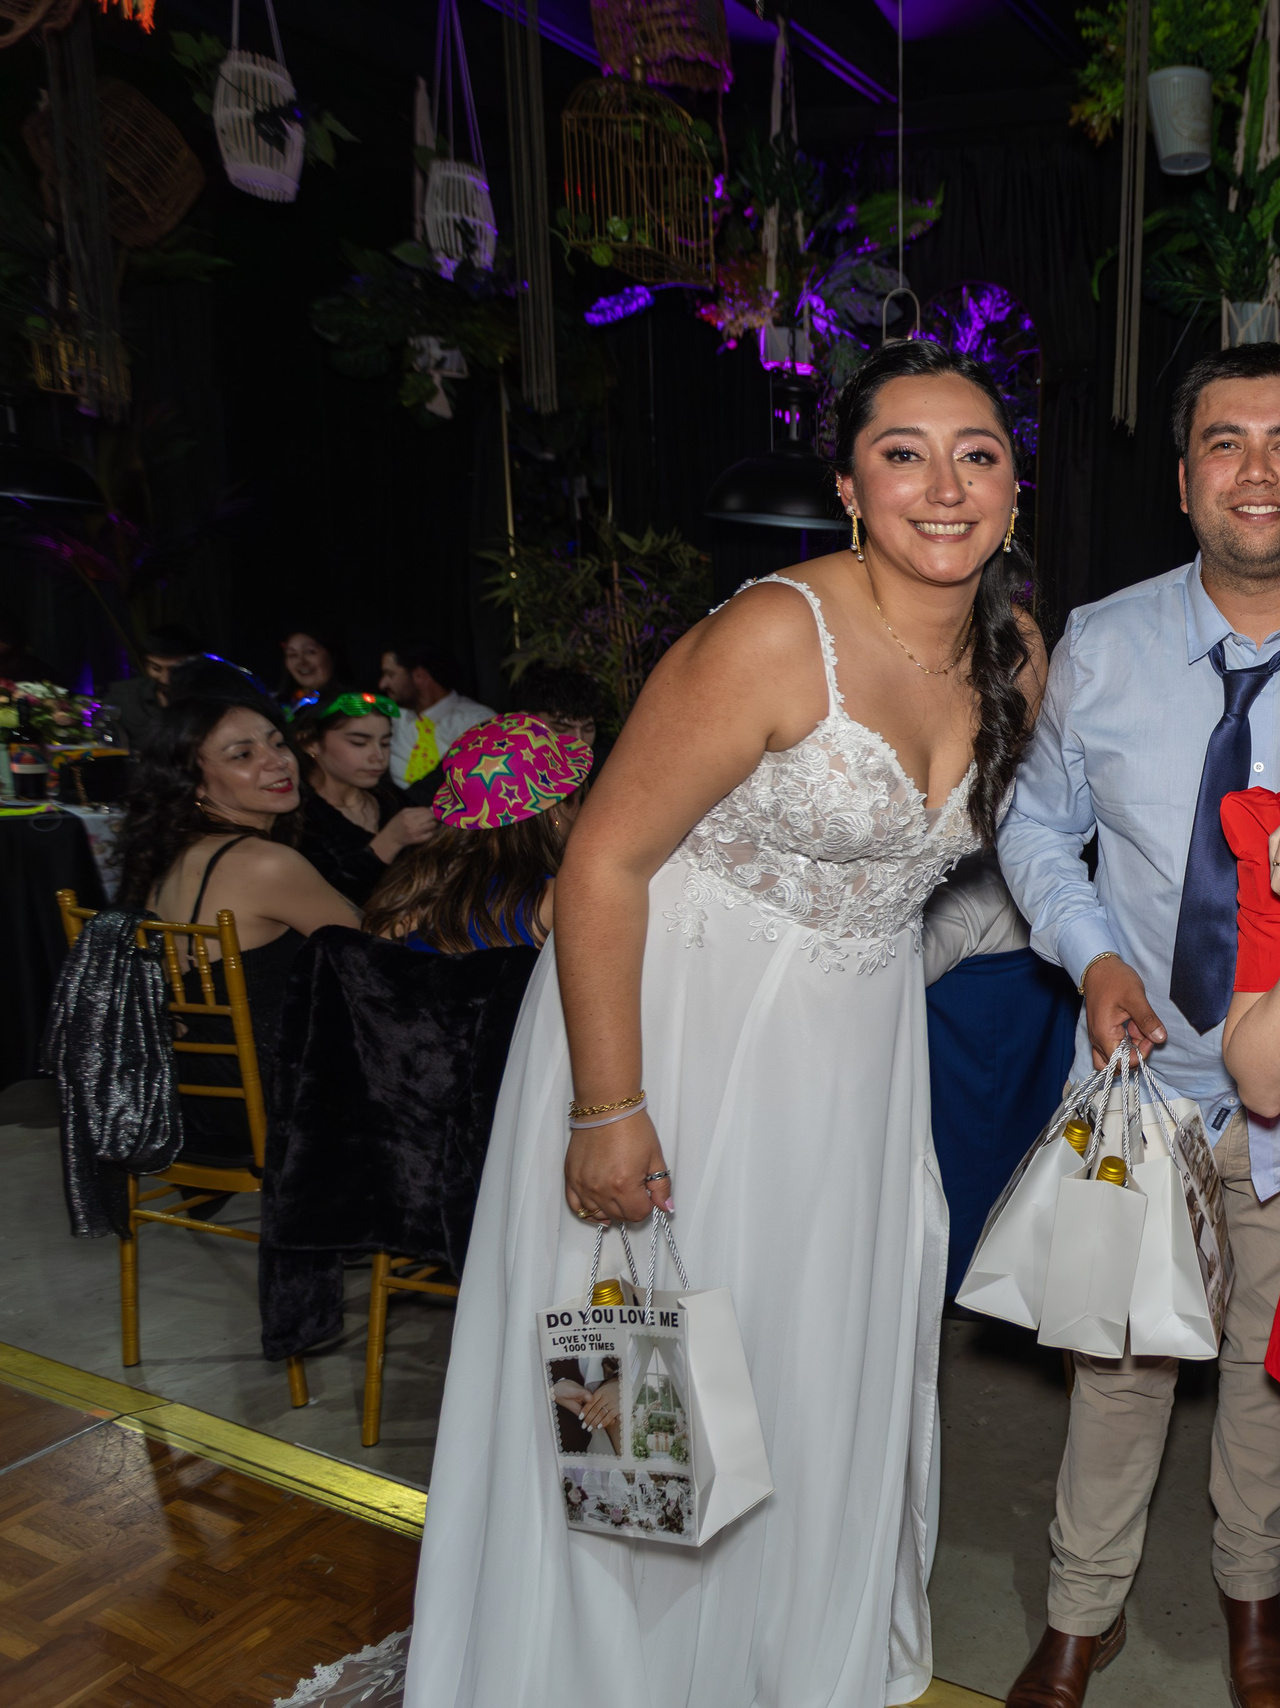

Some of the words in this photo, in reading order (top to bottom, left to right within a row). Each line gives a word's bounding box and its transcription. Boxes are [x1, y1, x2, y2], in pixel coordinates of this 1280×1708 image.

[546, 1311, 573, 1329] DO
[578, 1309, 614, 1324] YOU
[660, 1311, 679, 1328] ME
[552, 1335, 580, 1346] LOVE
[581, 1333, 602, 1343] YOU
[563, 1343, 587, 1353] 1000
[588, 1342, 615, 1351] TIMES
